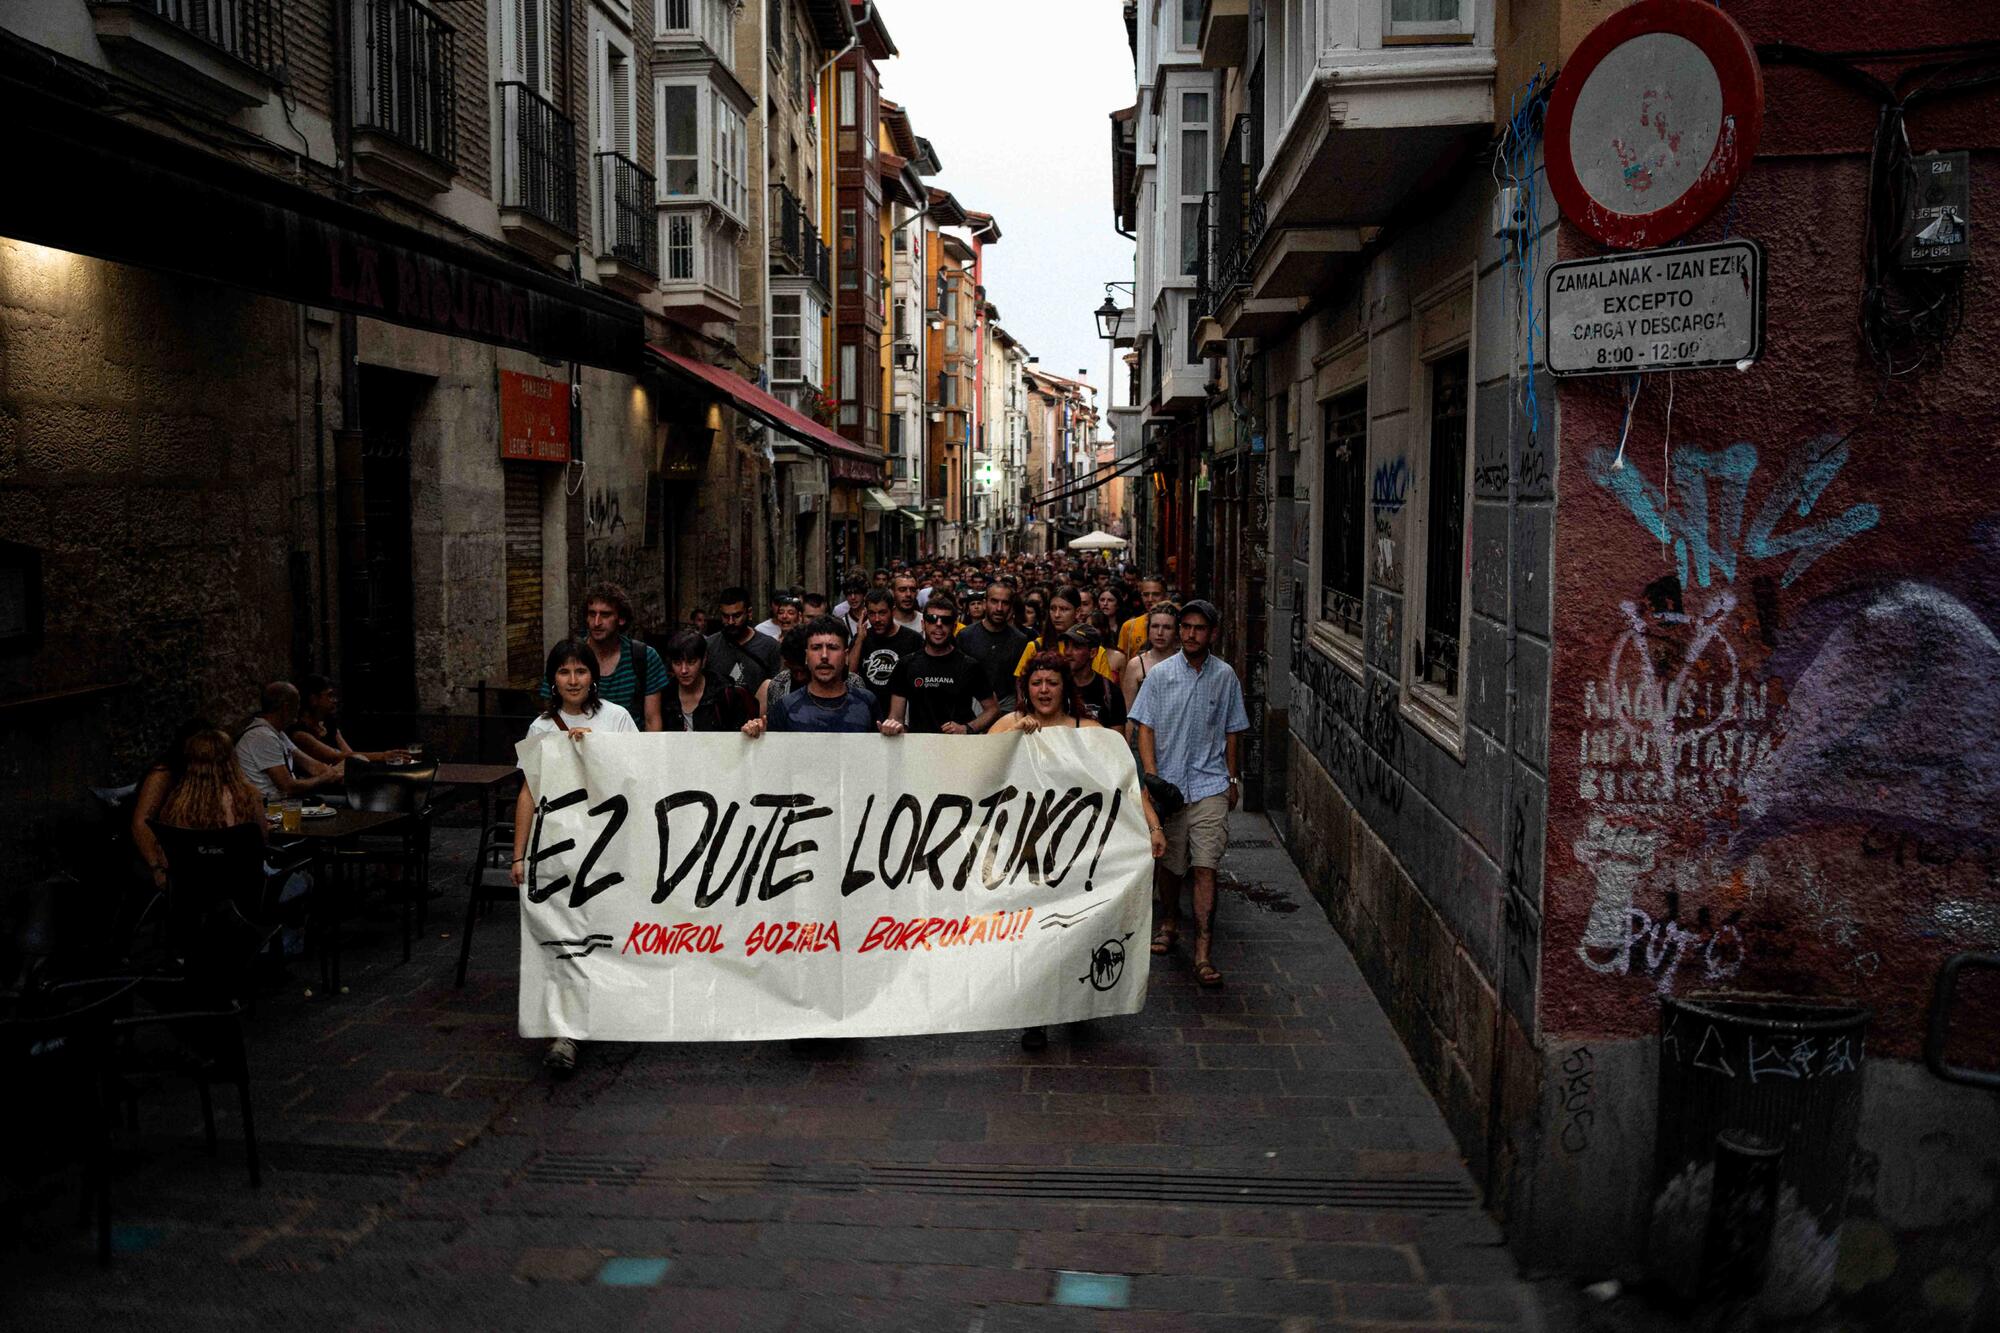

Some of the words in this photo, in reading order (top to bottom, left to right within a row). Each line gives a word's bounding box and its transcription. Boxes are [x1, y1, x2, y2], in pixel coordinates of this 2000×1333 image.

[1933, 163, 1950, 173] 27
[326, 239, 384, 308] LA
[1556, 265, 1652, 292] ZAMALANAK
[1666, 259, 1704, 281] IZAN
[1603, 290, 1693, 314] EXCEPTO
[1574, 321, 1624, 340] CARGA
[1628, 320, 1637, 336] Y
[1642, 313, 1726, 335] DESCARGA
[1597, 347, 1633, 363] 8:00
[527, 788, 628, 908] EZ
[650, 790, 833, 909] DUTE
[841, 784, 1122, 897] LORTUKO!
[621, 921, 724, 955] KONTROL
[858, 905, 1034, 954] BORROKATU!!
